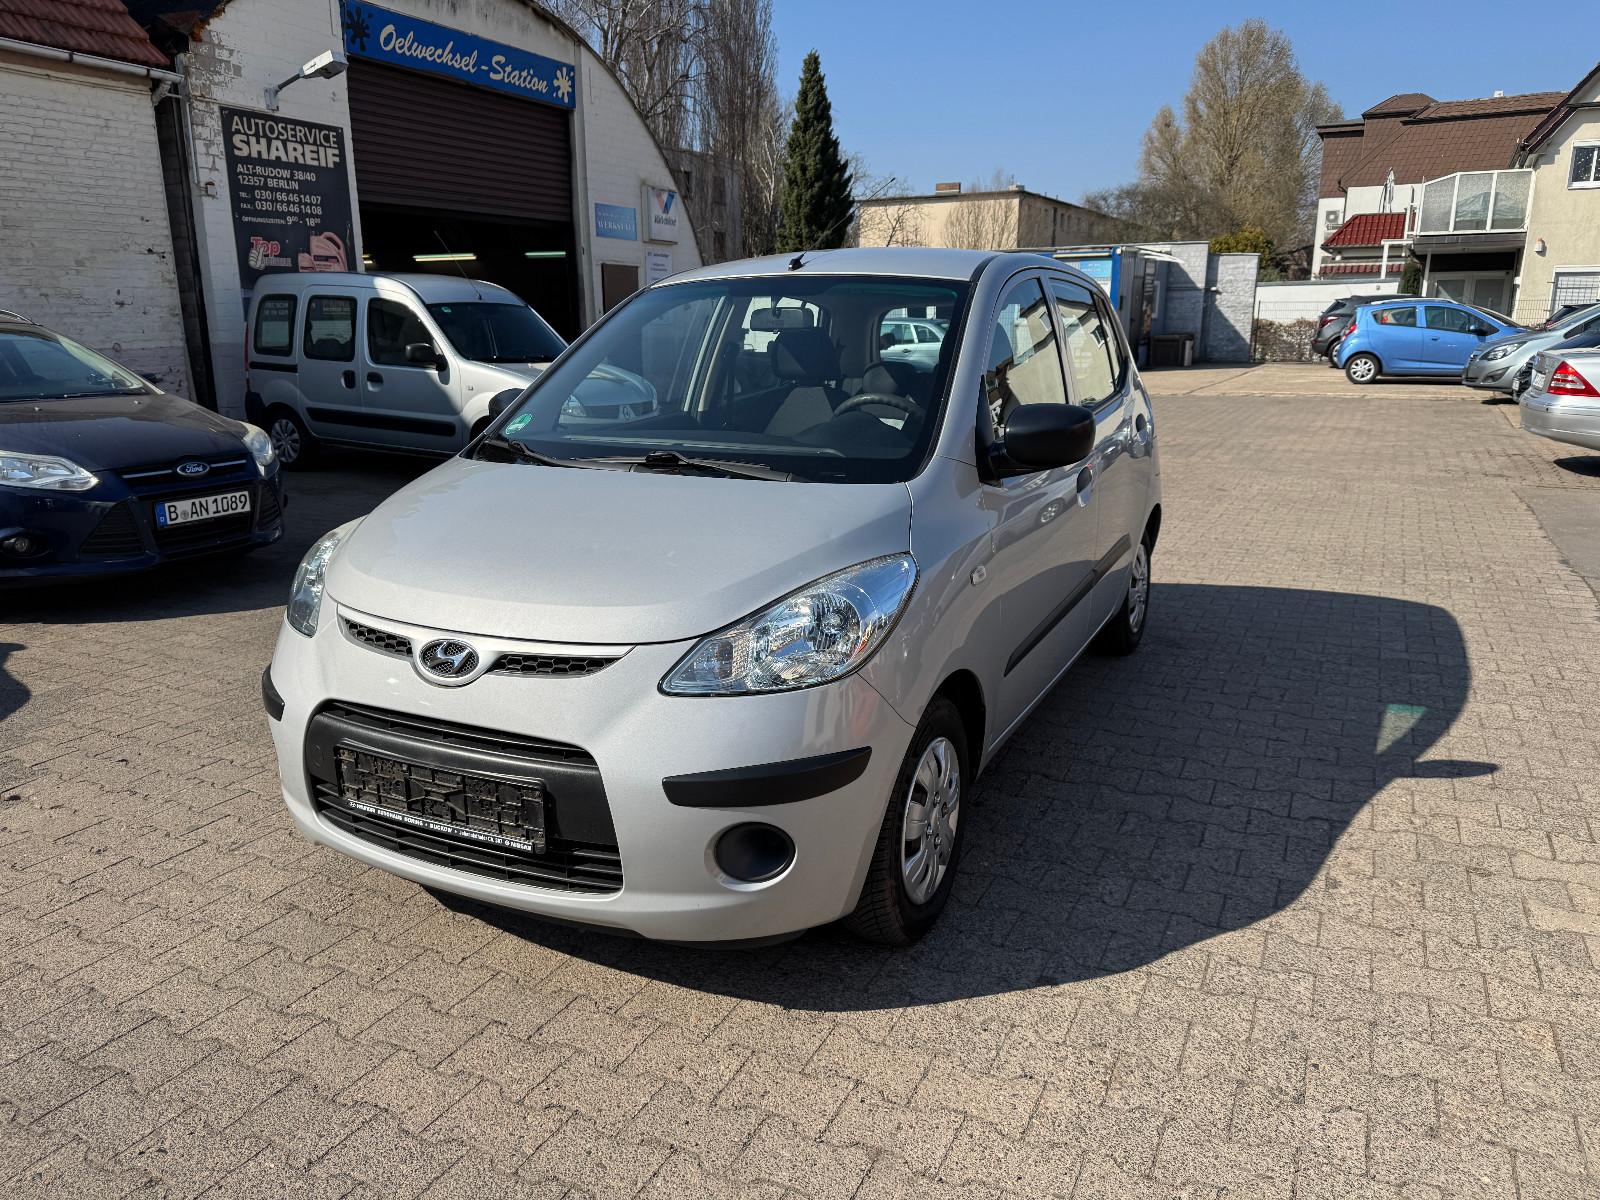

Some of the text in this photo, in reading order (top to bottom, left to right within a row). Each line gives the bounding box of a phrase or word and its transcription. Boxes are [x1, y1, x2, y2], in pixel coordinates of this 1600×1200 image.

[379, 24, 478, 74] Oelwechsel
[231, 115, 338, 148] AUTOSERVICE
[232, 133, 340, 169] SHAREIF
[236, 163, 316, 182] ALT-RUDOW 38/40
[238, 175, 299, 190] 12357 BERLIN
[185, 463, 204, 473] Ford
[167, 493, 248, 522] B AN 1089
